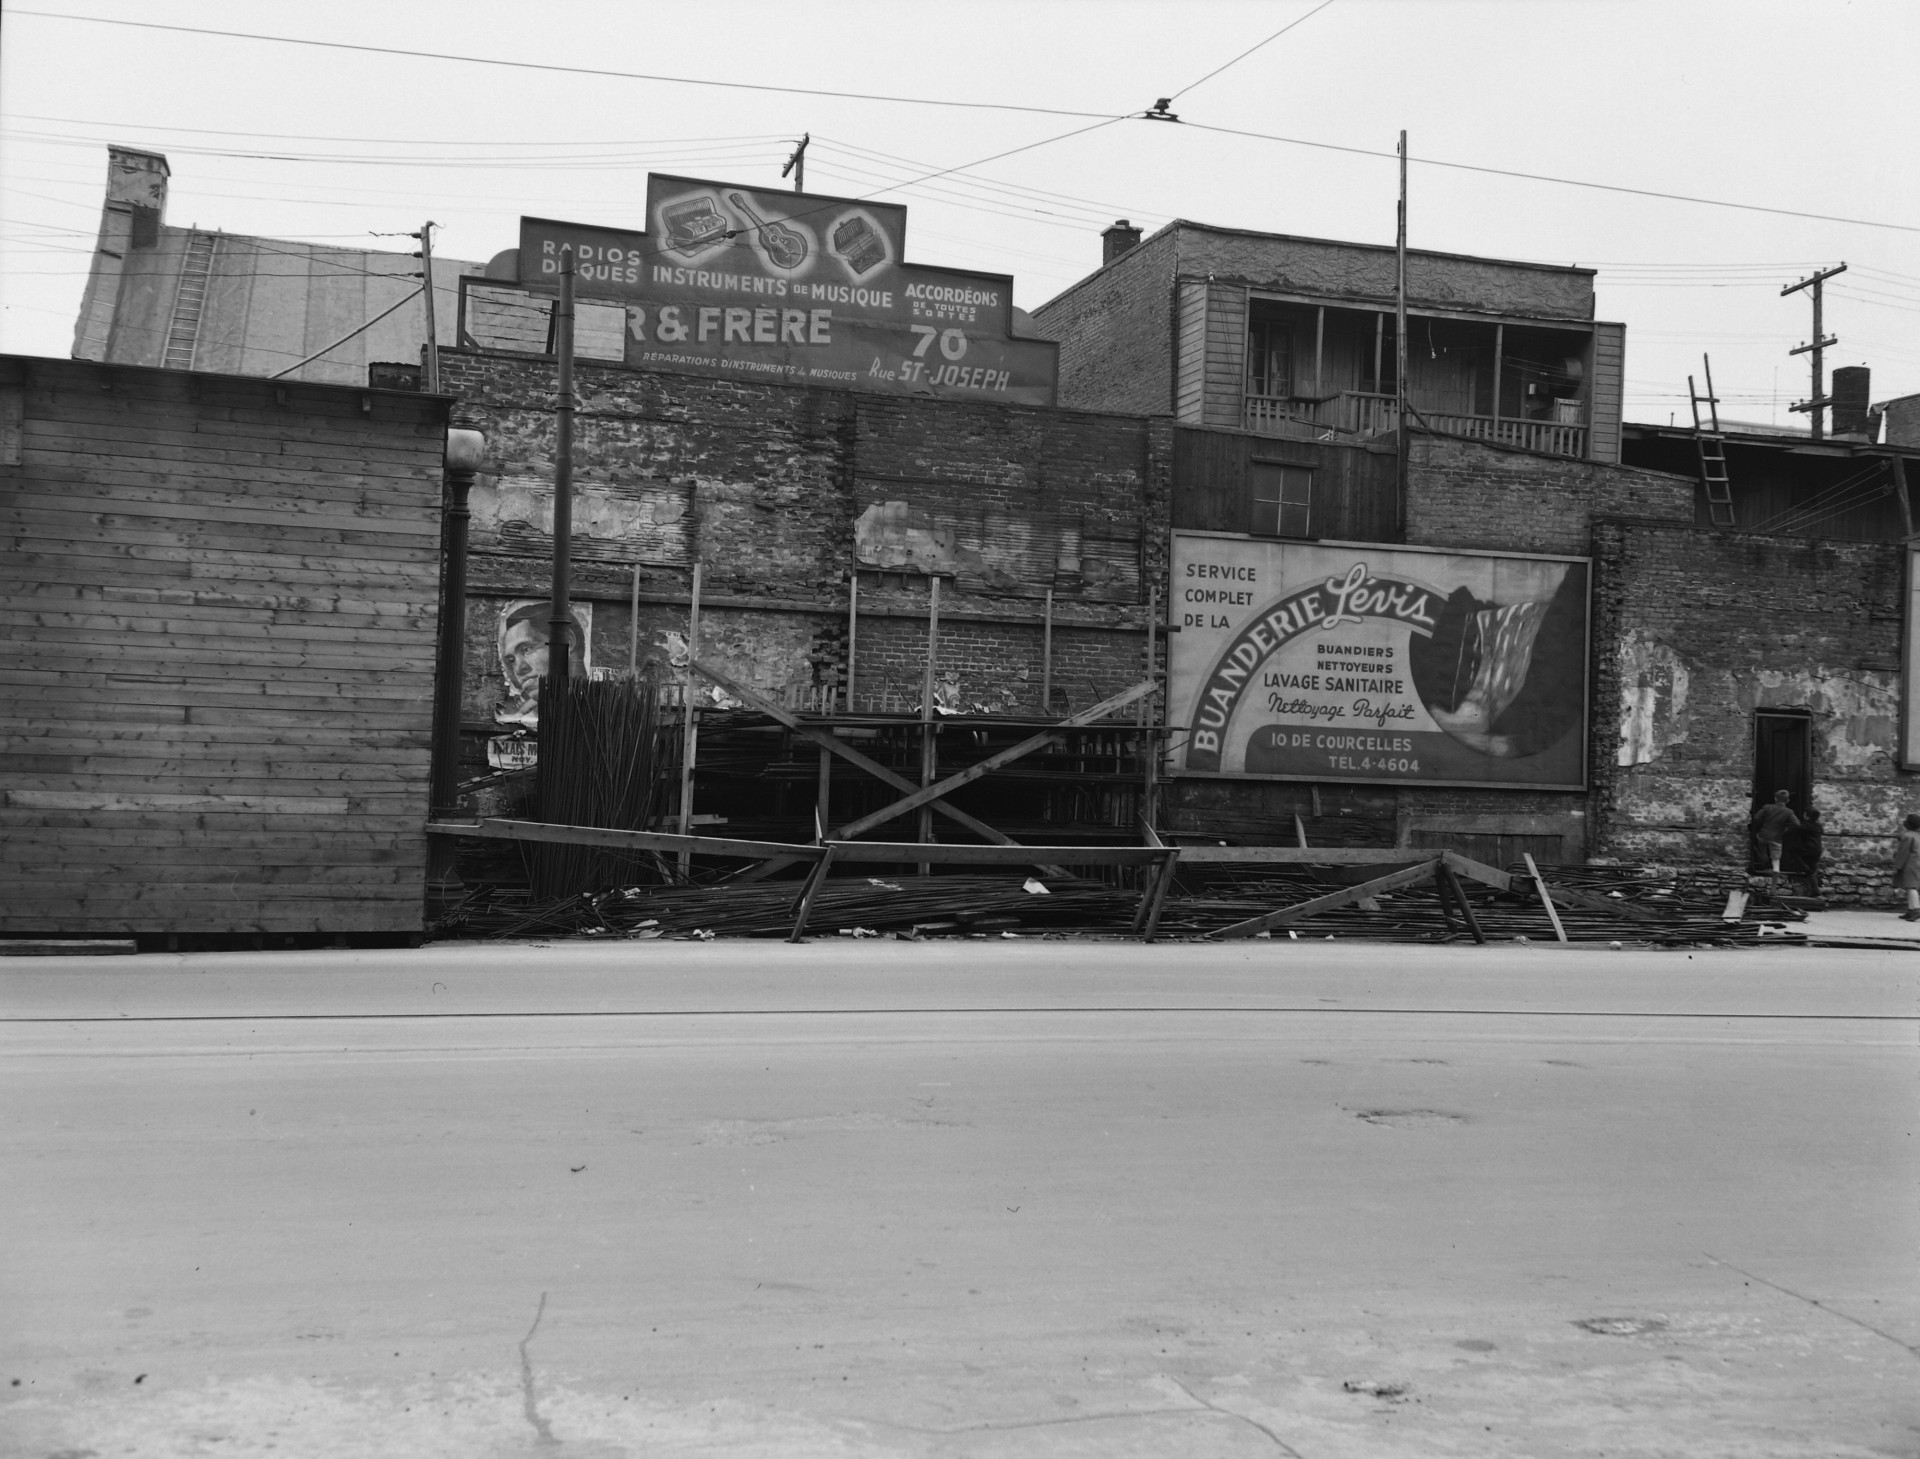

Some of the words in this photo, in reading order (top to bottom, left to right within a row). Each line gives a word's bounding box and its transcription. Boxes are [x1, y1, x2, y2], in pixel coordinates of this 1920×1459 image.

[543, 240, 640, 266] RADIOS
[542, 258, 638, 284] DIQUES
[653, 265, 787, 296] INSTRUMENTS
[793, 284, 808, 296] DE
[812, 284, 893, 308] MUSIQUE
[905, 282, 998, 307] ACCORDÉONS
[912, 308, 976, 322] SORTES
[913, 301, 926, 309] DE
[934, 303, 977, 314] TOUTES
[656, 306, 688, 342] &
[910, 324, 968, 361] 70
[643, 351, 717, 367] RÉPARATIONS
[809, 368, 857, 381] MUSIQUES
[868, 356, 895, 381] Rue
[898, 360, 1011, 392] ST-JOSEPH
[1186, 563, 1257, 582] SERVICE
[1185, 588, 1254, 606] COMPLET
[1184, 613, 1204, 627] DE
[1211, 614, 1230, 629] LA
[1193, 591, 1327, 755] BUANDERIE
[1321, 562, 1436, 630] Lévis
[1317, 644, 1394, 658] BUANDIERS
[1317, 660, 1393, 674] NETTOYEURS
[1264, 673, 1320, 691] LAVAGE
[1325, 676, 1404, 694] SANITAIRE
[1268, 692, 1346, 721] Nettoyage
[1353, 698, 1415, 728] Parfait
[1292, 733, 1311, 748] DE
[1317, 734, 1413, 752] COURCELLES
